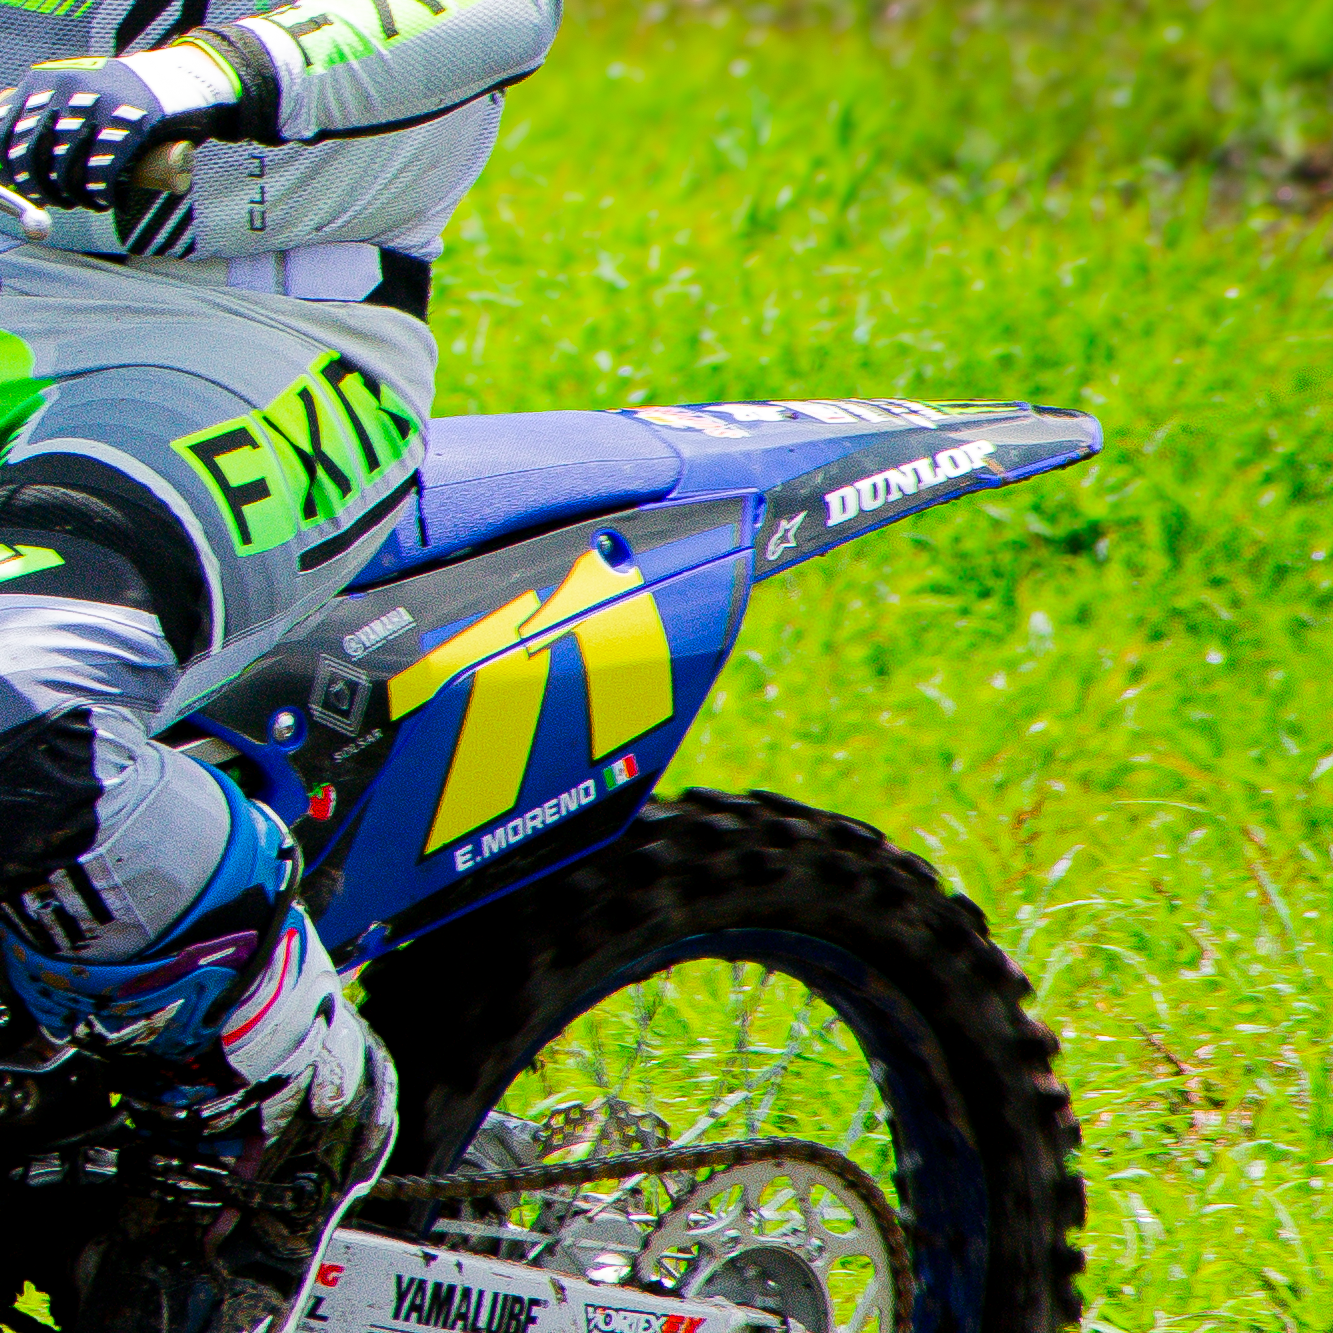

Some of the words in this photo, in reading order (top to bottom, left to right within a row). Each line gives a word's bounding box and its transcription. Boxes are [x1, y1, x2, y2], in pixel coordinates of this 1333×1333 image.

[187, 356, 412, 547] FXR
[824, 439, 996, 528] DUNLOP
[387, 549, 674, 856] 71
[454, 778, 597, 873] E.MORENO
[390, 1273, 550, 1333] YAMALUBE
